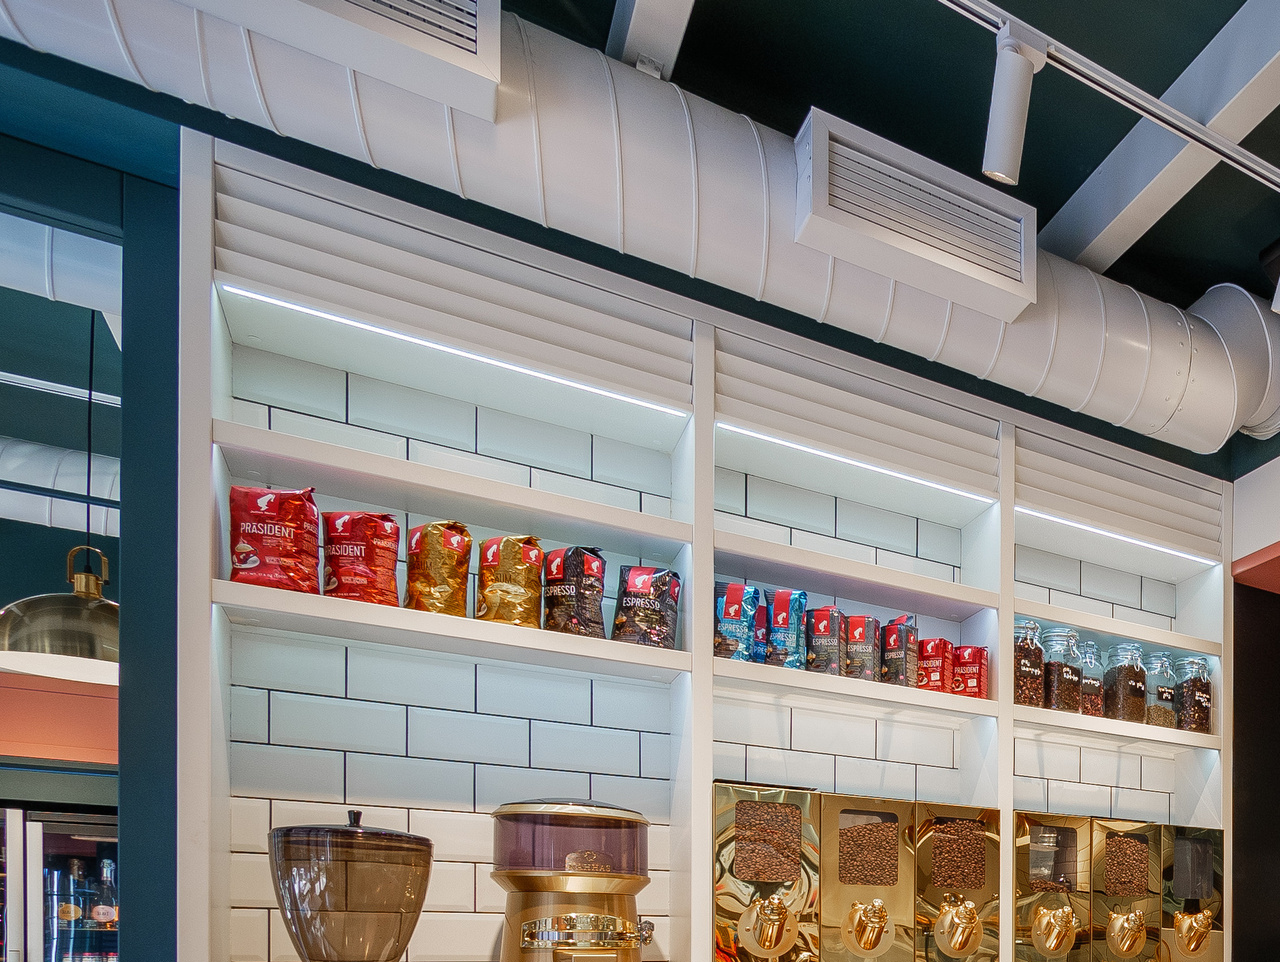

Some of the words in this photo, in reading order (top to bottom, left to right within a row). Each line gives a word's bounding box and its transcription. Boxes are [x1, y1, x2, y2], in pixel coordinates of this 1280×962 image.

[622, 596, 661, 611] ESPRESSO
[717, 621, 749, 633] ESPRESSO
[812, 637, 838, 646] ESPRESSO
[847, 644, 873, 653] ESPRESSO
[884, 650, 905, 660] ESPRESSO
